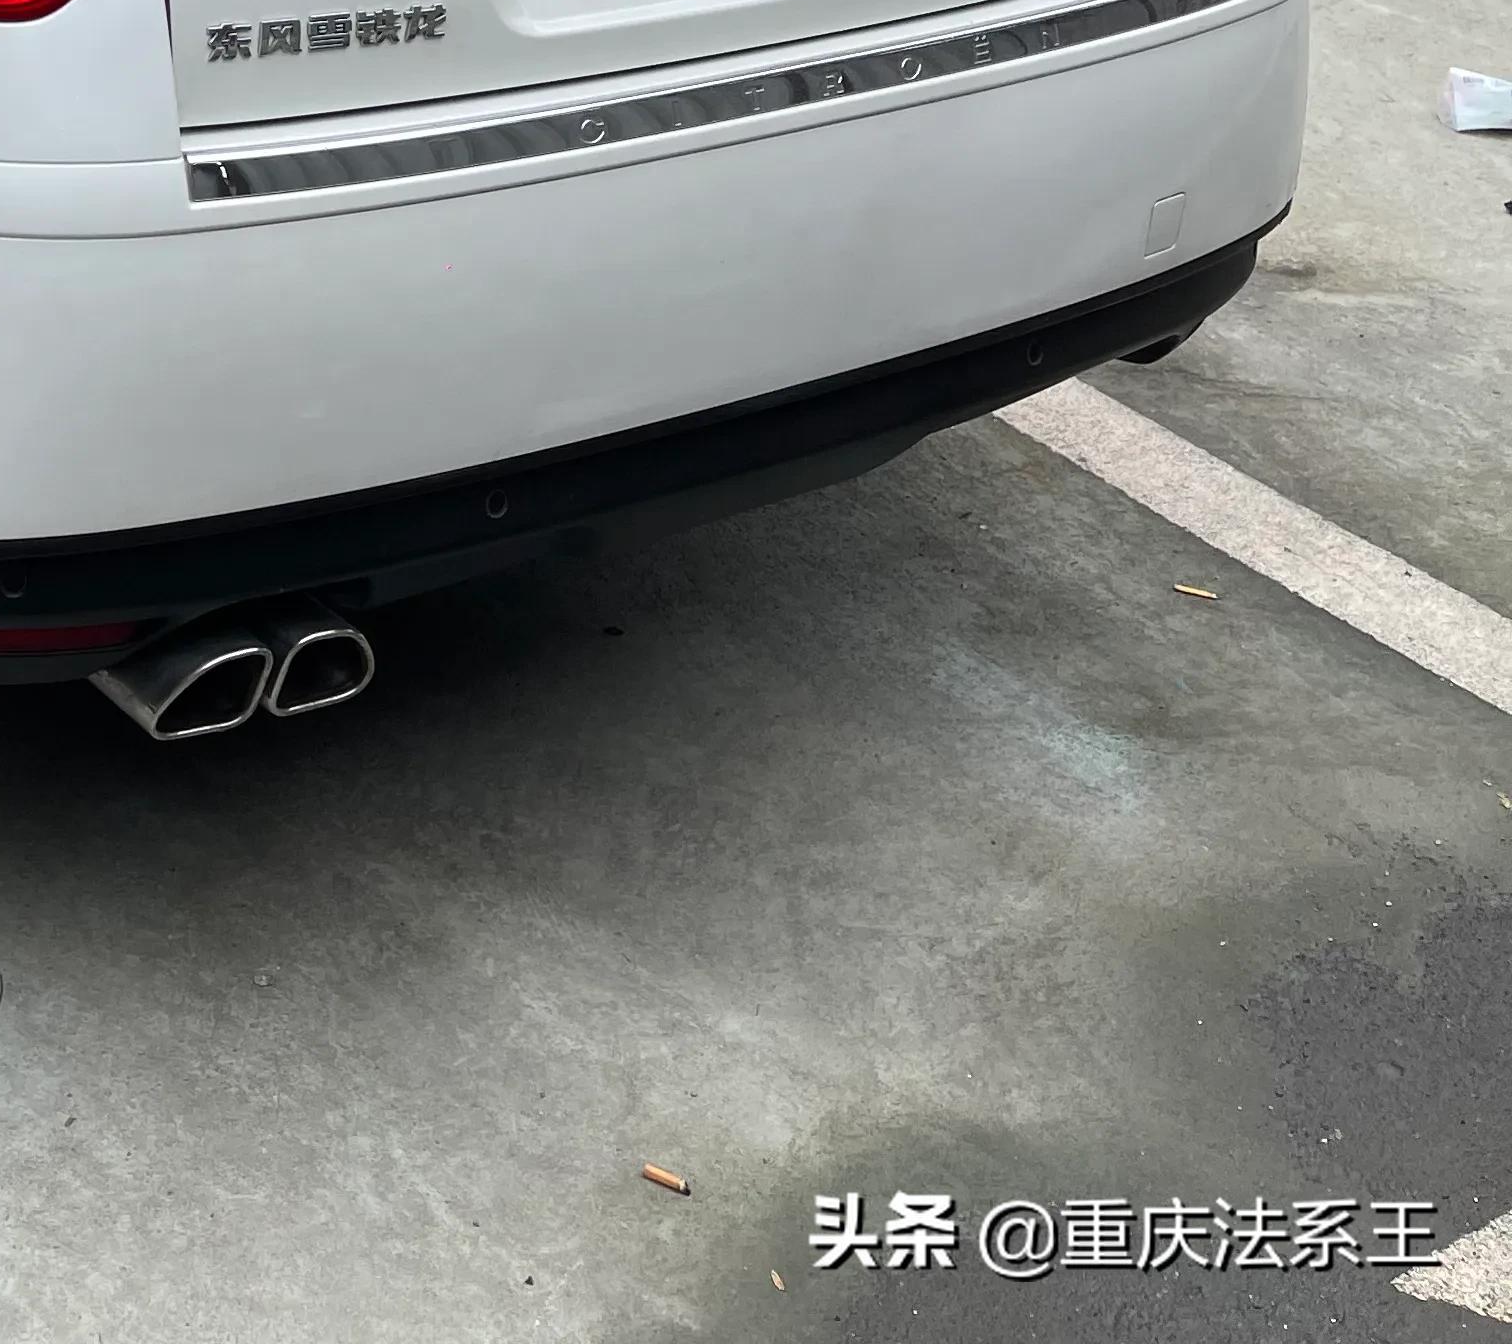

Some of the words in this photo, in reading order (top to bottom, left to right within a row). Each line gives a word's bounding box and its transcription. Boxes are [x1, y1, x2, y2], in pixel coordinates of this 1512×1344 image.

[206, 3, 447, 62] 东风雪铁龙
